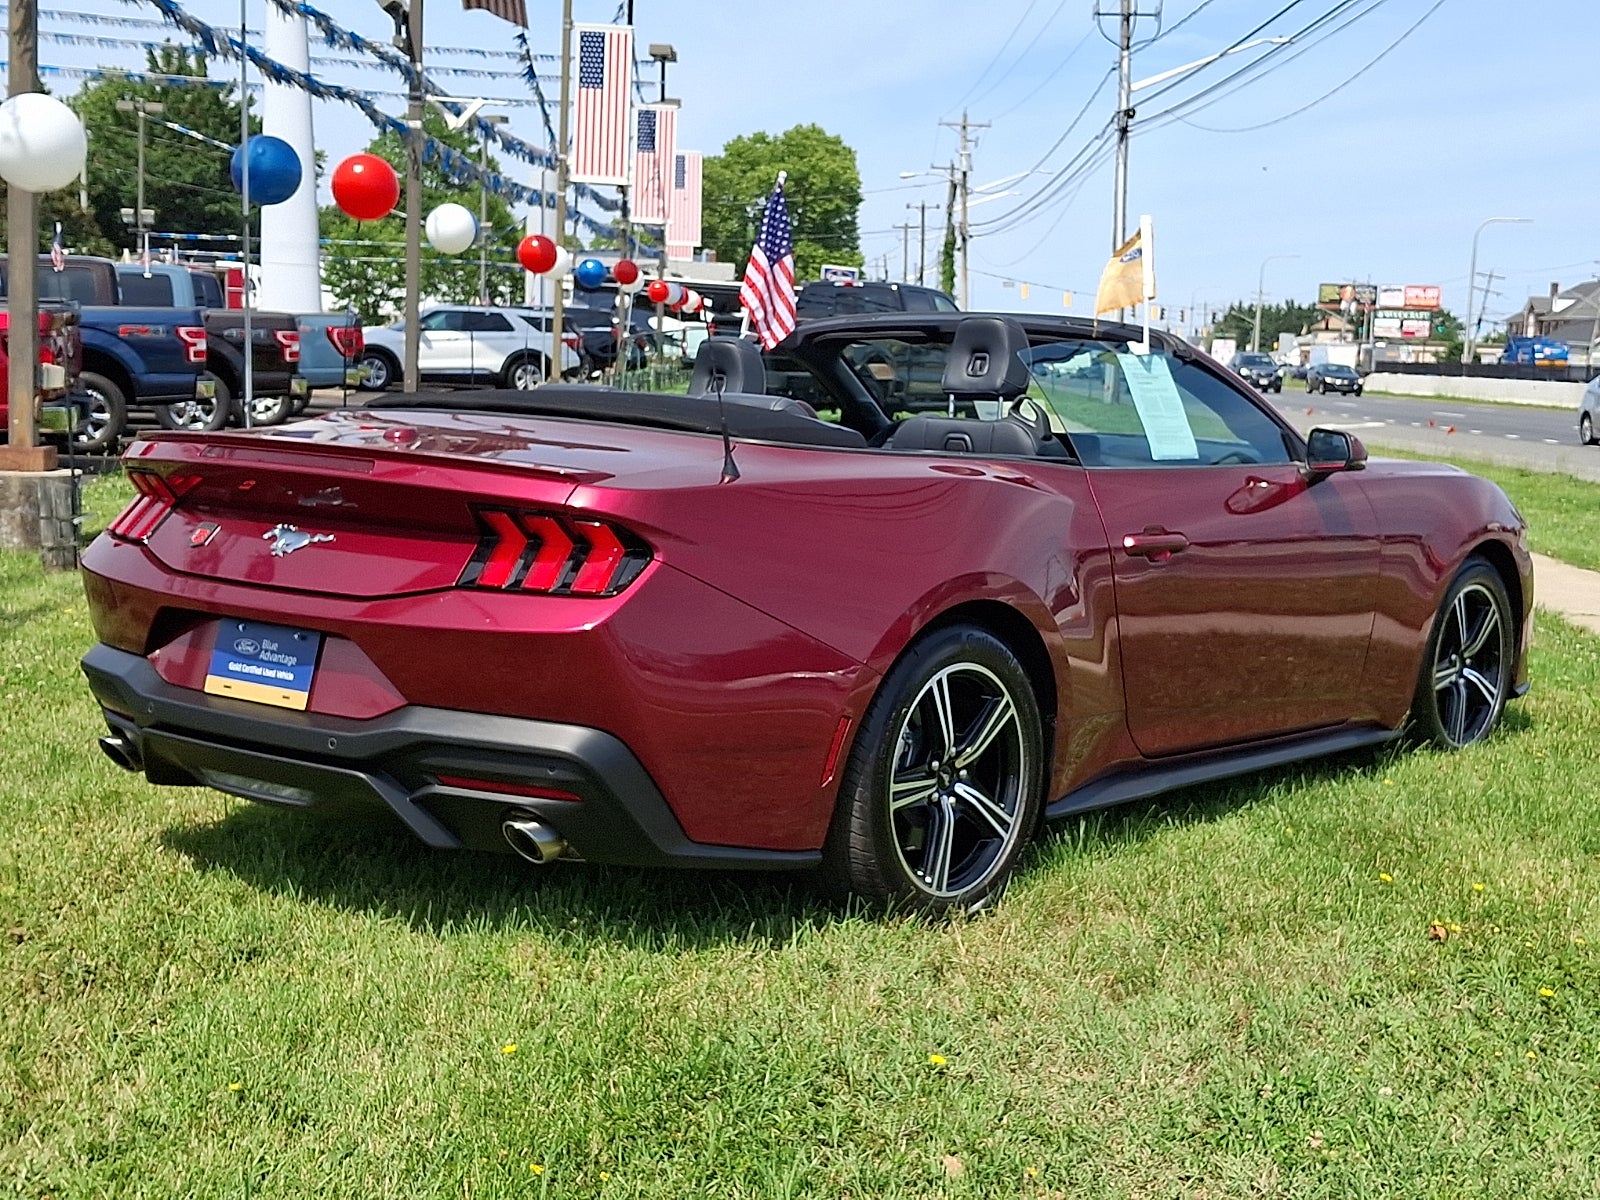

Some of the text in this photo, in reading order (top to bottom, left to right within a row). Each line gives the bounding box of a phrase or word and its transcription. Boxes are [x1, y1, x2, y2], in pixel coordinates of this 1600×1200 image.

[118, 324, 165, 338] FX4
[237, 640, 257, 653] Ford
[261, 639, 278, 651] Blue
[259, 650, 297, 666] Advantage
[228, 662, 242, 672] Gold
[242, 664, 262, 675] Certified
[262, 667, 276, 678] Used
